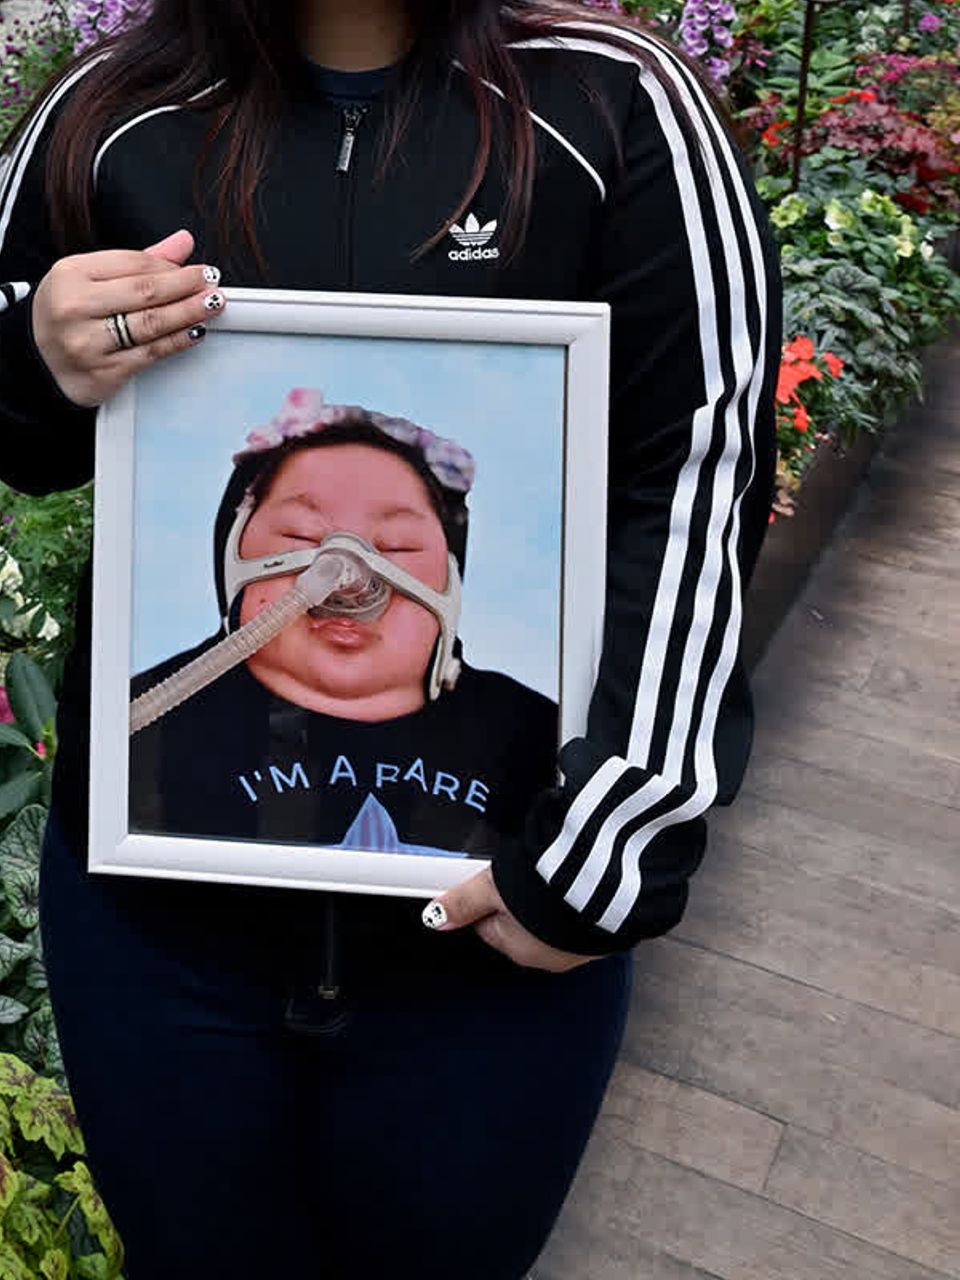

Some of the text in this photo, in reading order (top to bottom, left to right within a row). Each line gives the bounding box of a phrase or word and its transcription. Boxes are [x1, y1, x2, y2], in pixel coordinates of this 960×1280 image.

[448, 247, 500, 261] adidas
[239, 762, 310, 802] I'M
[329, 755, 357, 787] A
